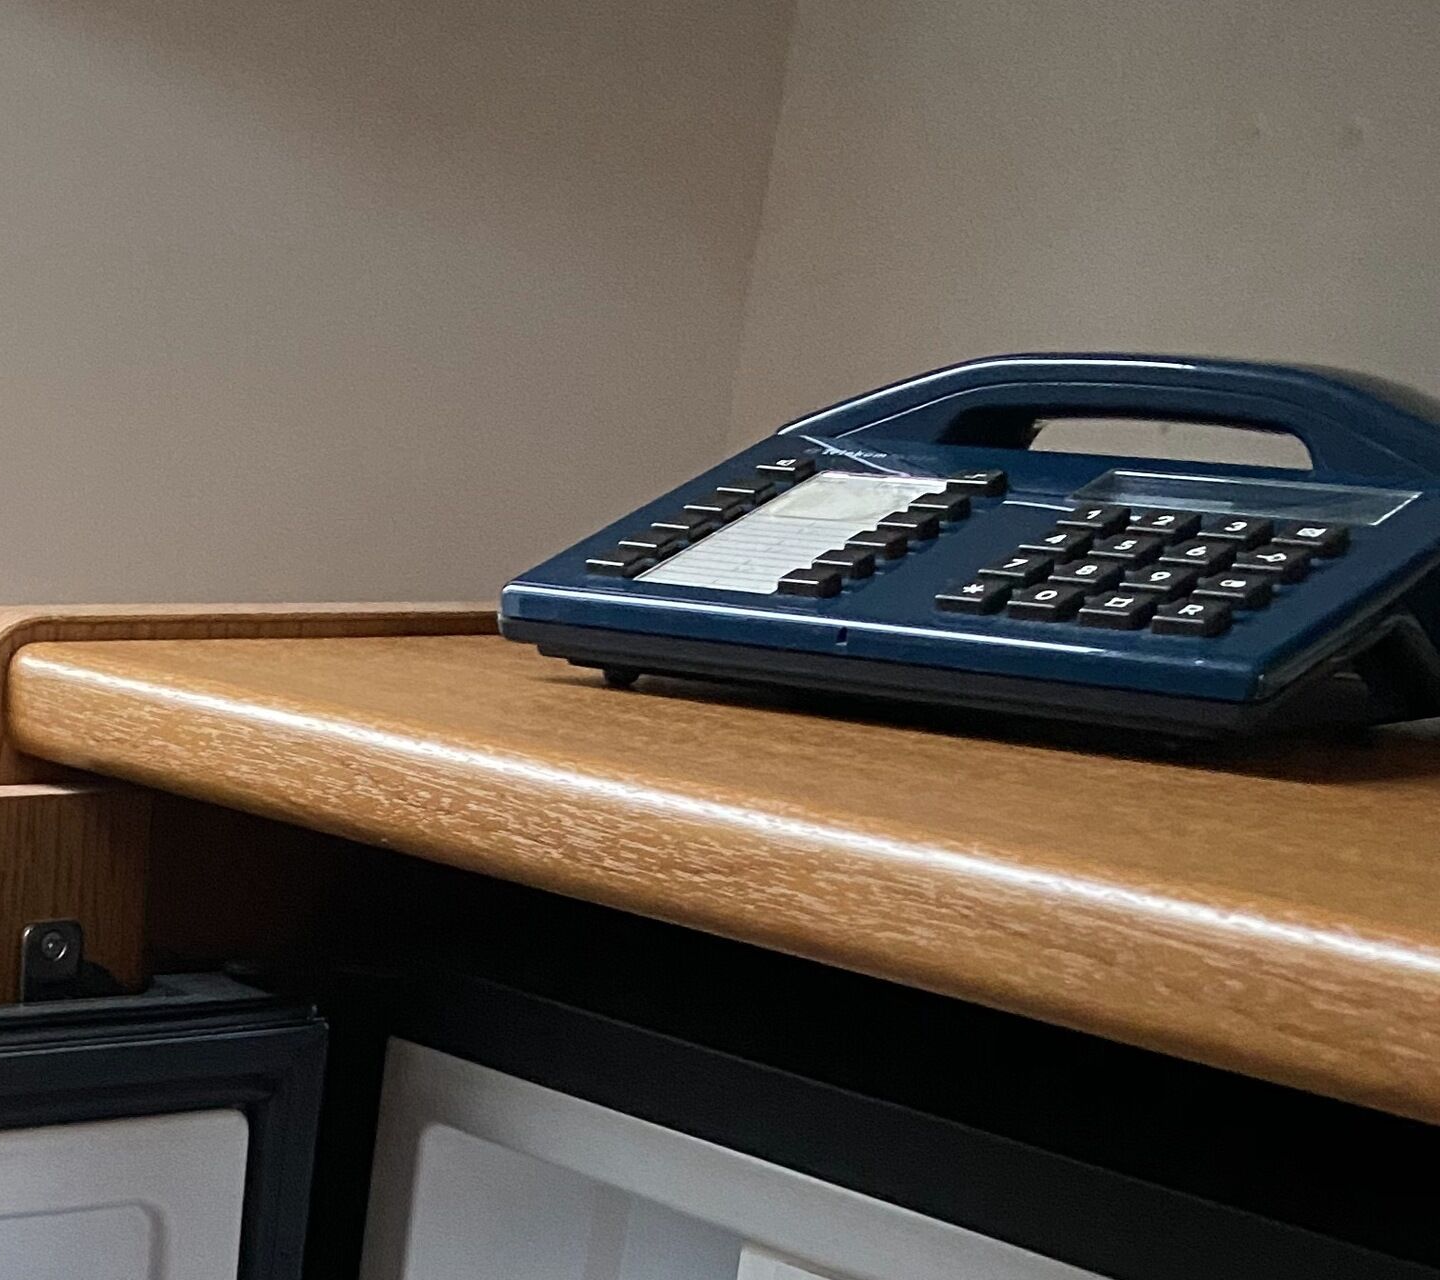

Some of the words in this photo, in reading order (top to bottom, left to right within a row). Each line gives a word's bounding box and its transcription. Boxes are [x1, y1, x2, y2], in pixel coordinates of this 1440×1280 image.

[1152, 515, 1175, 527] 2
[1225, 520, 1248, 533] 3
[1046, 533, 1068, 545] 4
[1114, 539, 1137, 552] 5
[1186, 545, 1209, 558] 6
[1003, 558, 1029, 570] 7
[1076, 564, 1098, 577] 8
[1178, 604, 1206, 617] R
